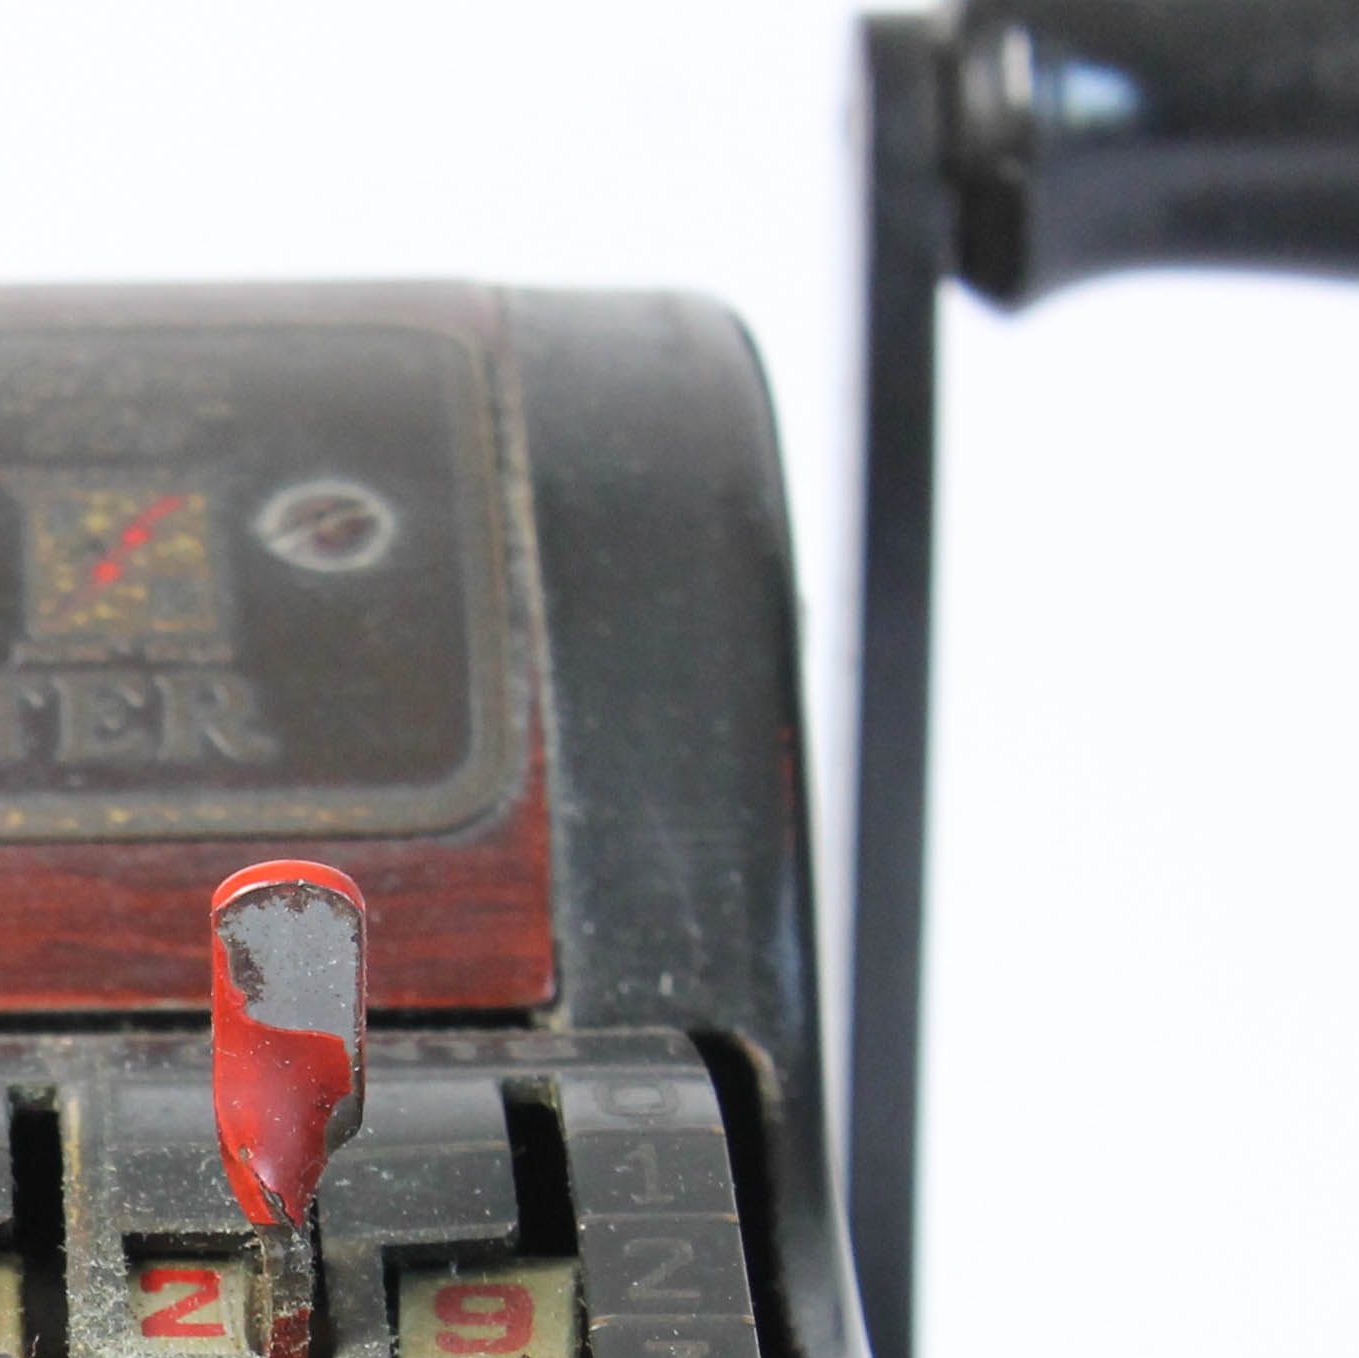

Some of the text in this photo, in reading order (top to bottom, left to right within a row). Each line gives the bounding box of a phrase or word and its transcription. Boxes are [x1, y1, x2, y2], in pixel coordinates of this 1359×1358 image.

[622, 1235, 702, 1300] 2
[140, 1268, 226, 1338] 2
[434, 1284, 535, 1354] 9
